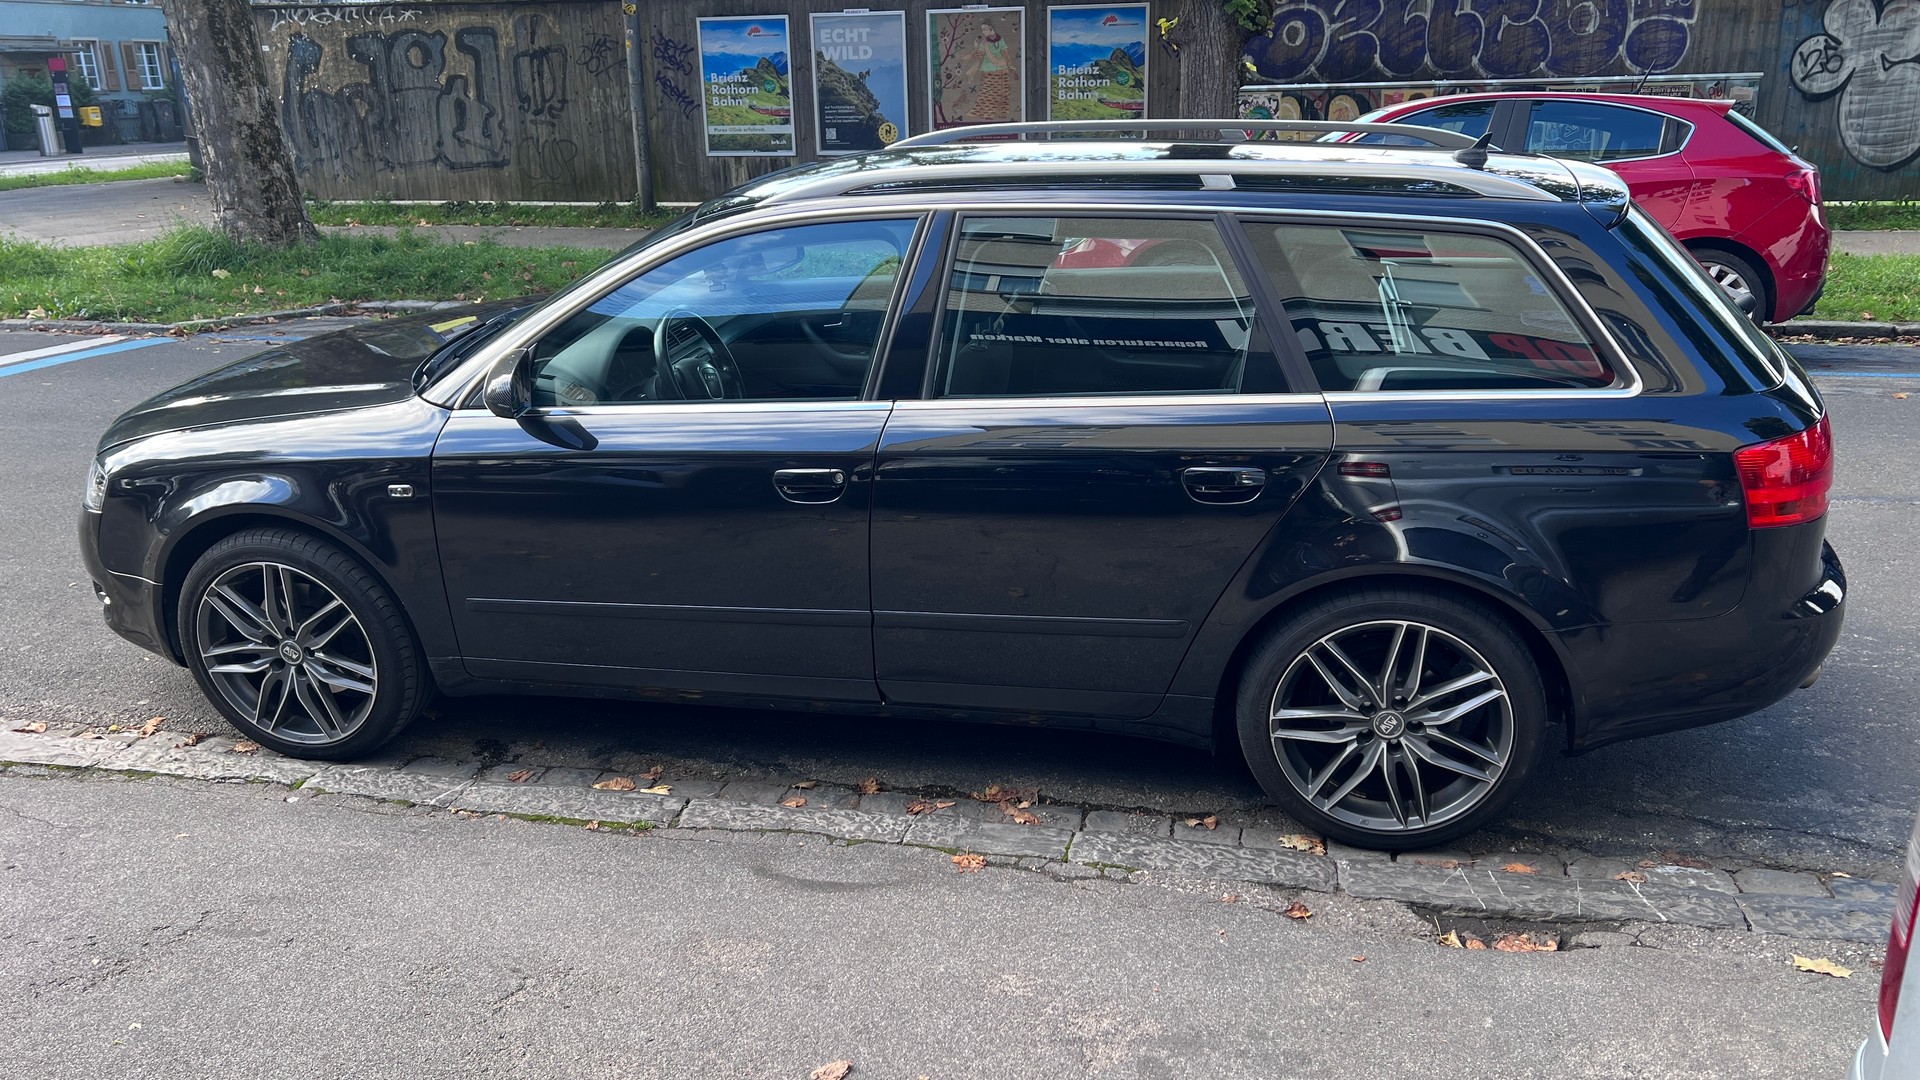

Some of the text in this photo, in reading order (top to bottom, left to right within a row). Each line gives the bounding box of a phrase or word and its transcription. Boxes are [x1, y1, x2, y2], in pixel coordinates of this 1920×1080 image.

[820, 28, 870, 43] ECHT
[821, 45, 873, 61] WILD
[1799, 38, 1844, 82] 25
[1058, 64, 1100, 75] Brienz
[710, 72, 748, 83] Brienz
[1059, 76, 1110, 88] Rothorn
[711, 84, 759, 95] Rothorn
[1058, 89, 1092, 100] Bahn
[712, 96, 743, 106] Bahn
